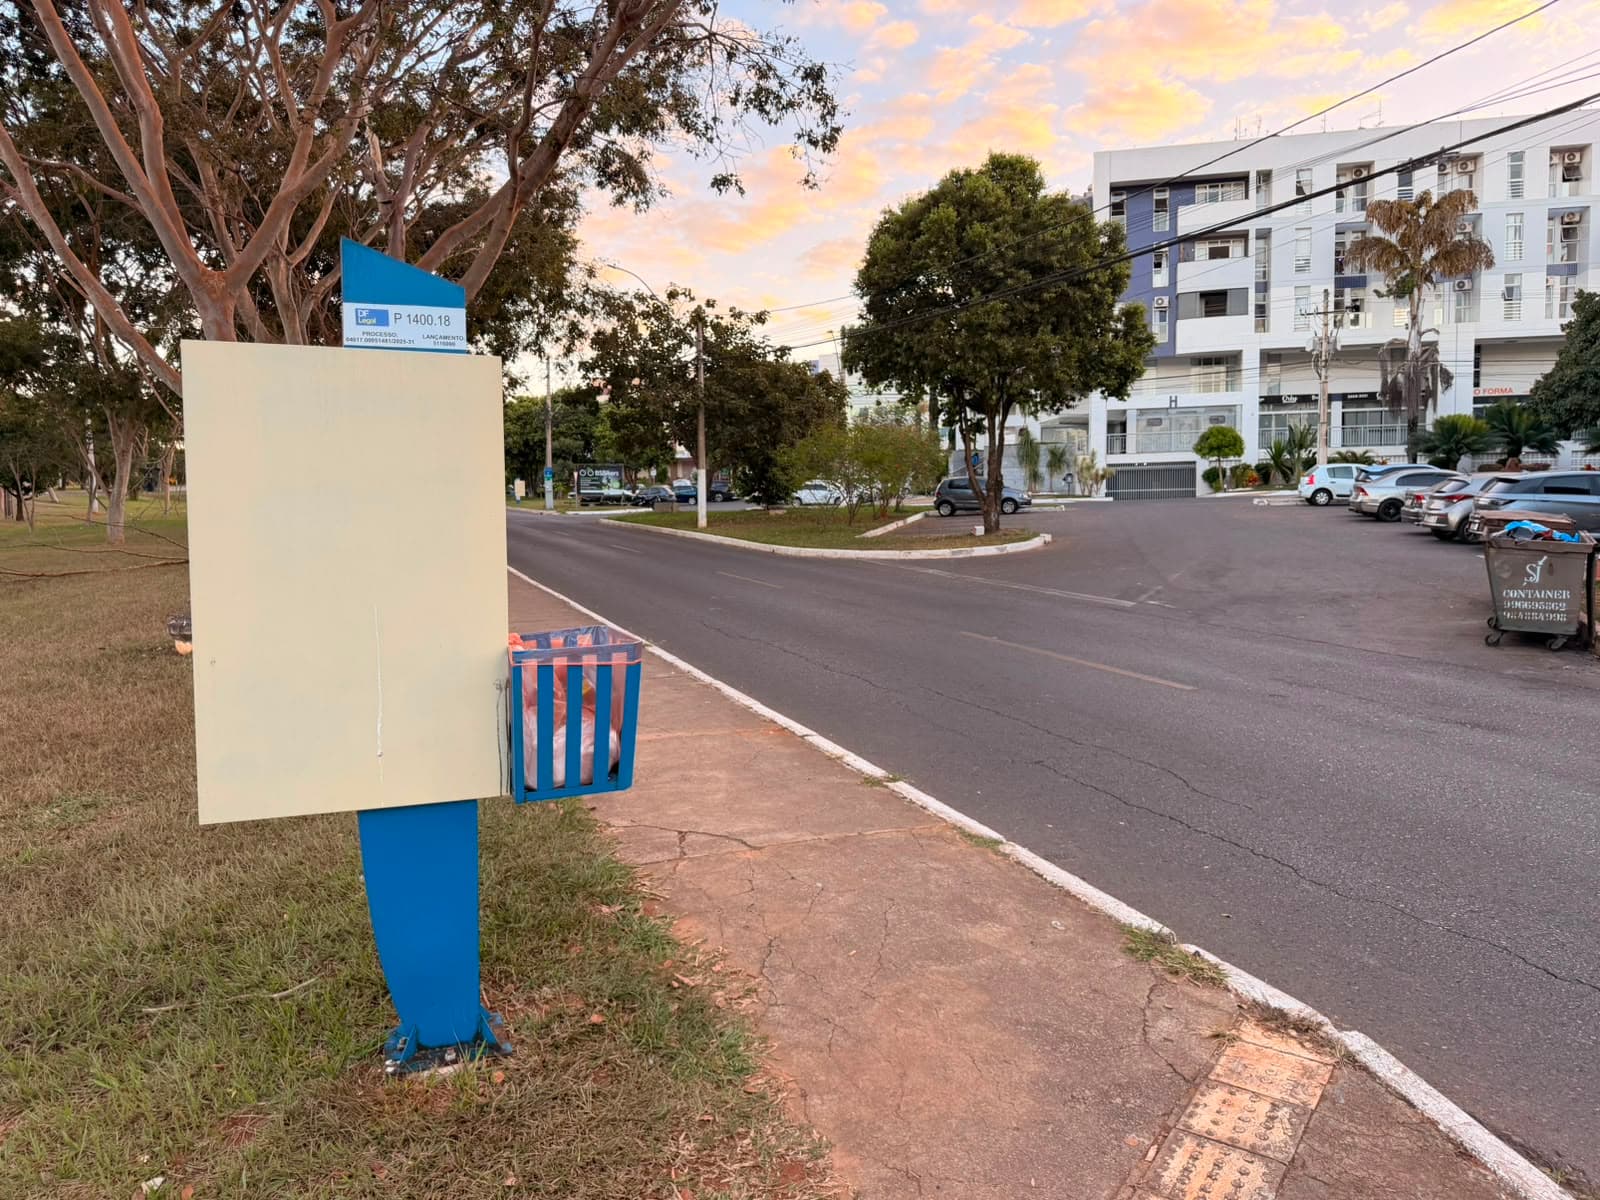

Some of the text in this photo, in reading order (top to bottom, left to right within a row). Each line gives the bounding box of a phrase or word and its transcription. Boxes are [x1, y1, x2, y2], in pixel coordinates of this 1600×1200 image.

[358, 309, 369, 317] DF
[394, 313, 451, 326] P 1400.18
[1482, 387, 1514, 395] FORMA
[1503, 589, 1571, 599] CONTAINER
